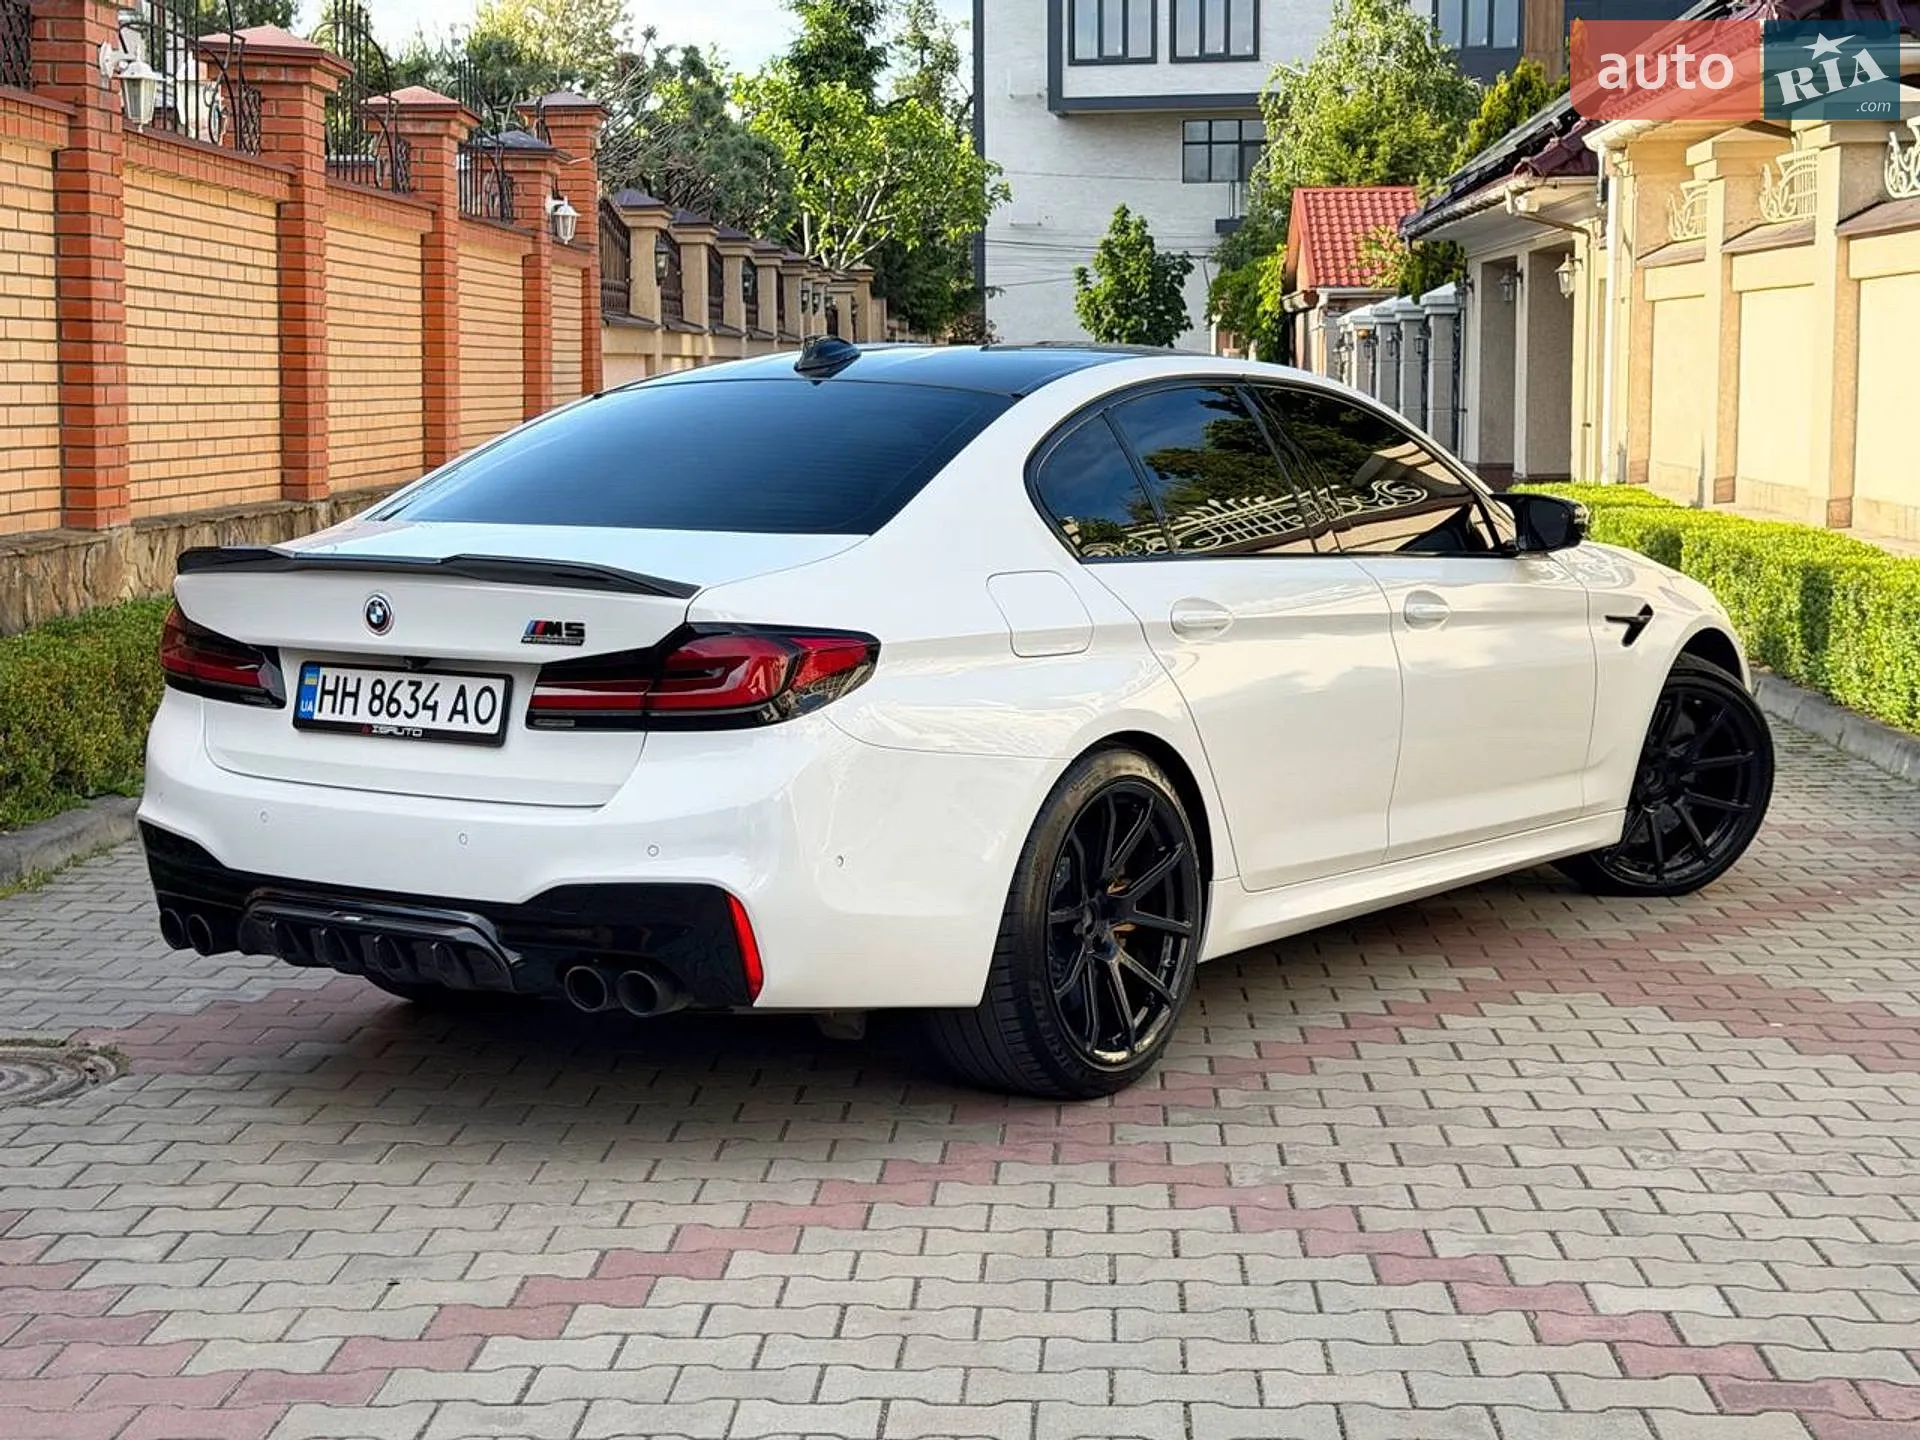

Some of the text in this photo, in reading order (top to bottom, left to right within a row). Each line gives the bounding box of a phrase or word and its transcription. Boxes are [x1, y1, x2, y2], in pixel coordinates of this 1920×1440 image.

[300, 701, 314, 713] UA
[317, 674, 498, 725] HH 8634 AO
